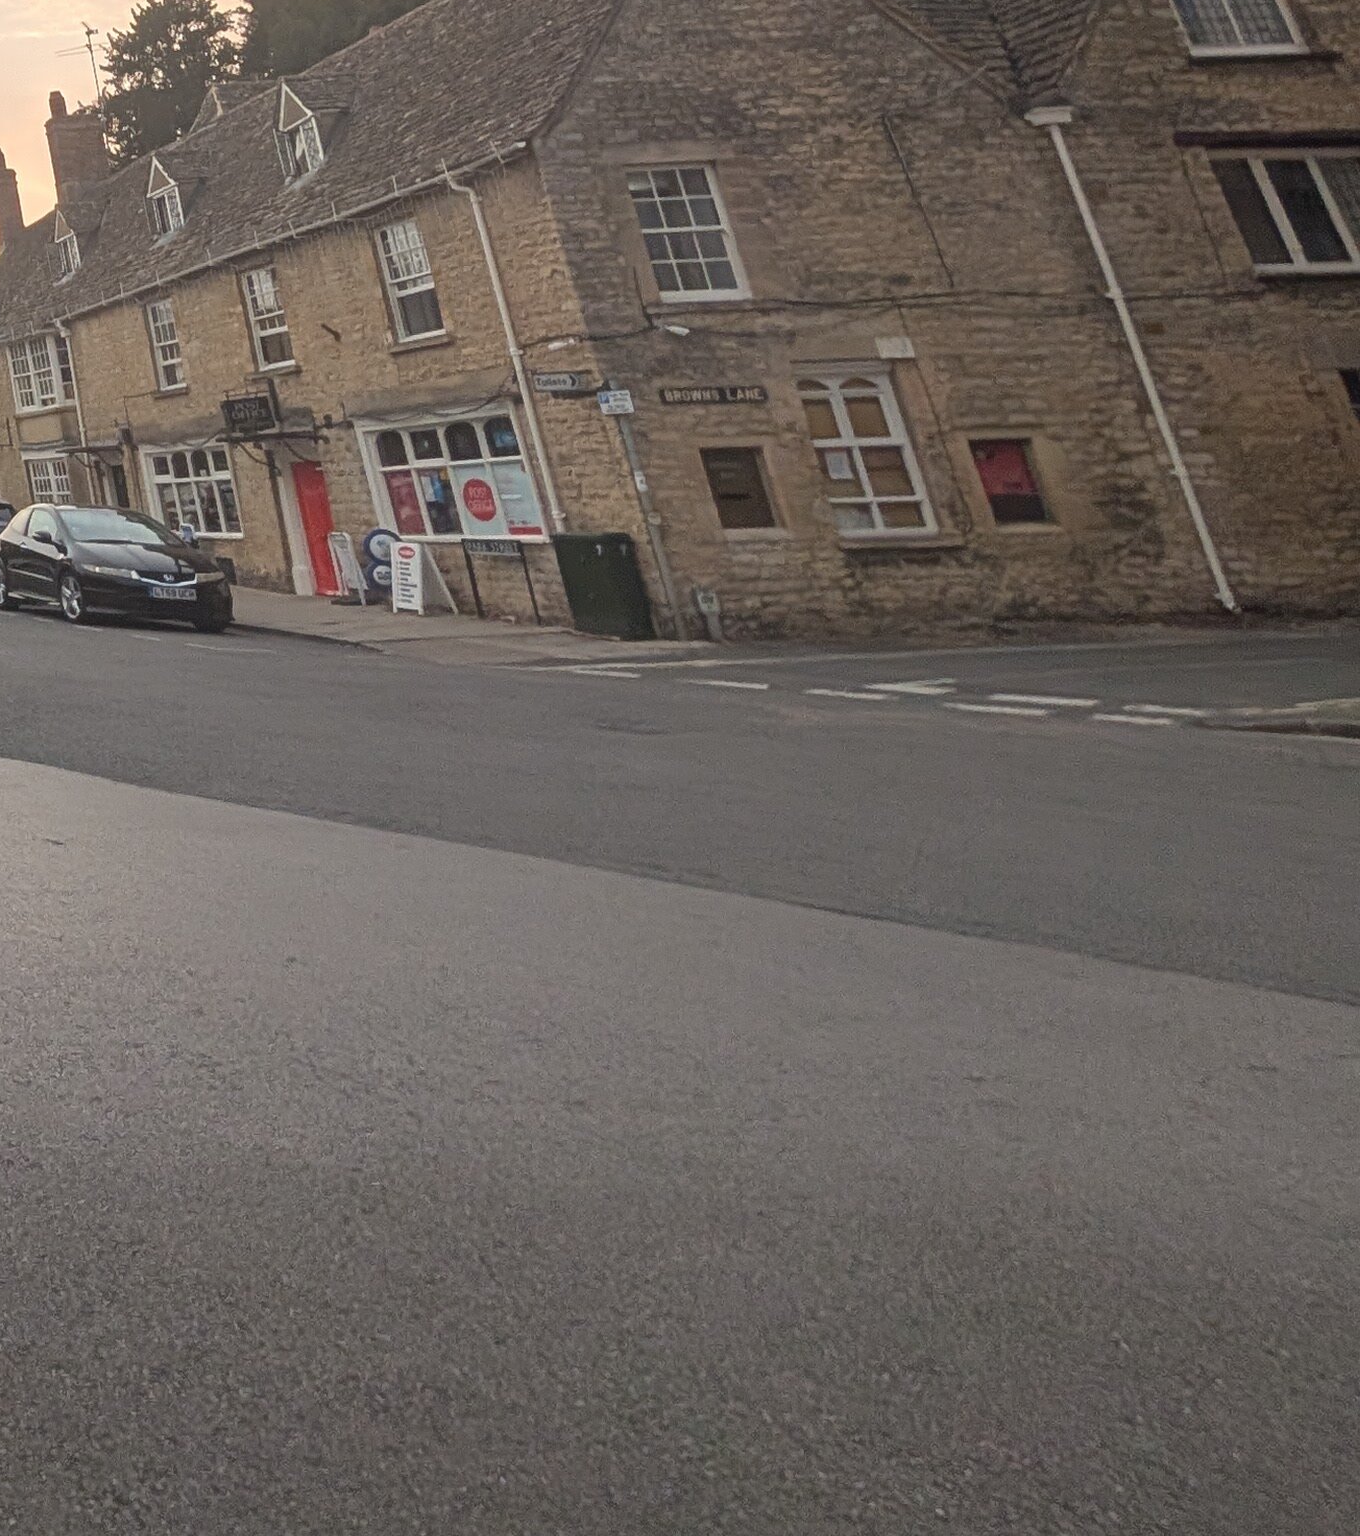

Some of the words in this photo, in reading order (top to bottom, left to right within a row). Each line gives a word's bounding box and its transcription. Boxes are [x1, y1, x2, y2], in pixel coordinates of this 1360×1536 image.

[535, 376, 568, 387] Toilets
[726, 387, 765, 402] LANE
[233, 400, 259, 412] POST
[467, 486, 487, 499] POST
